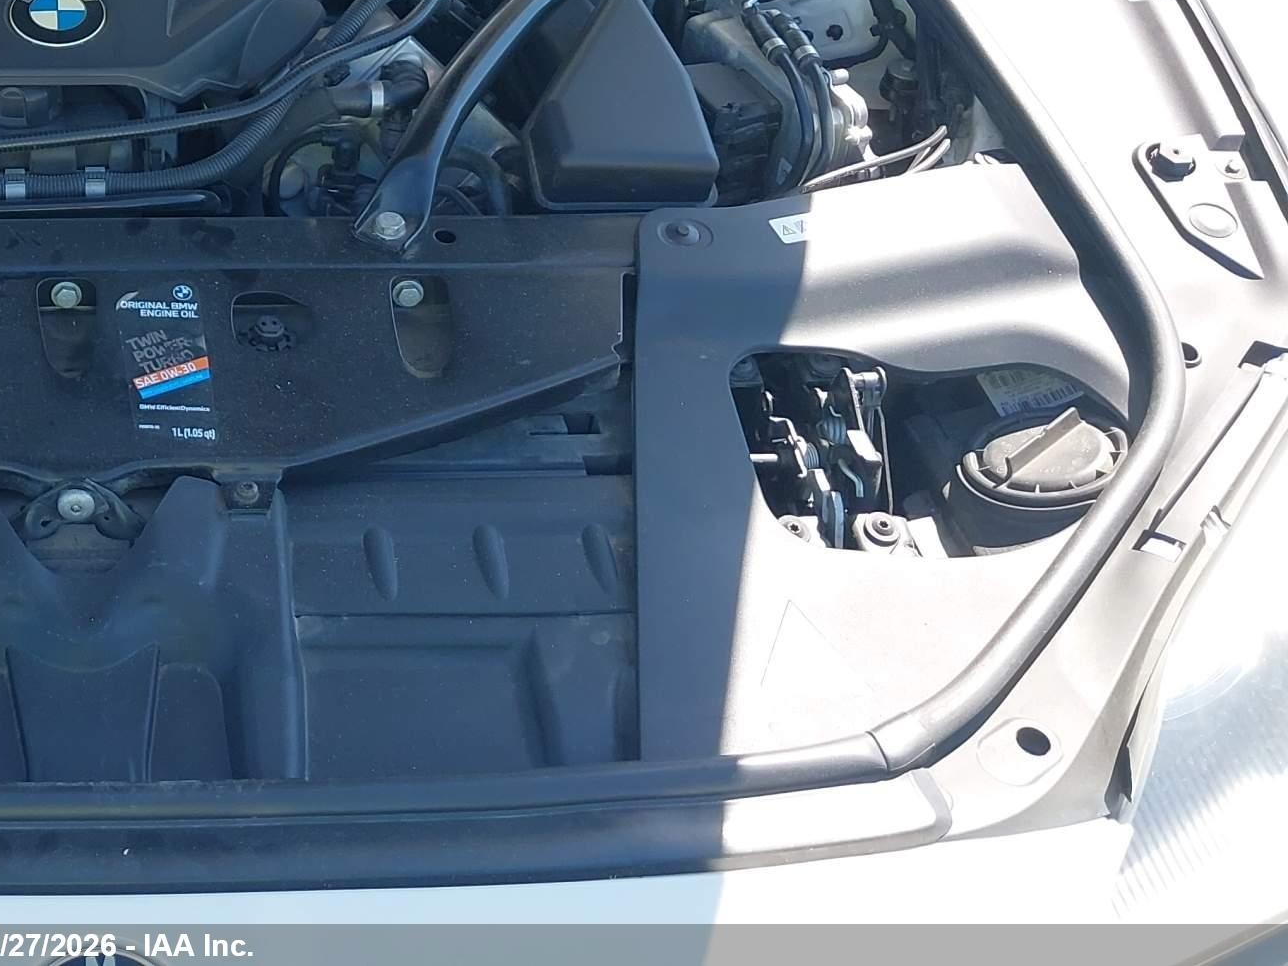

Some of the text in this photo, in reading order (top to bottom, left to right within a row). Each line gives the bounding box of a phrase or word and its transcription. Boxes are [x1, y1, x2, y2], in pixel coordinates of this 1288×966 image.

[120, 300, 198, 311] ORIGINAL BMW
[140, 309, 199, 318] ENGINE OIL
[125, 329, 168, 350] TWIN
[132, 336, 193, 362] POWER
[134, 374, 159, 389] SAE
[160, 362, 197, 380] 0W-30
